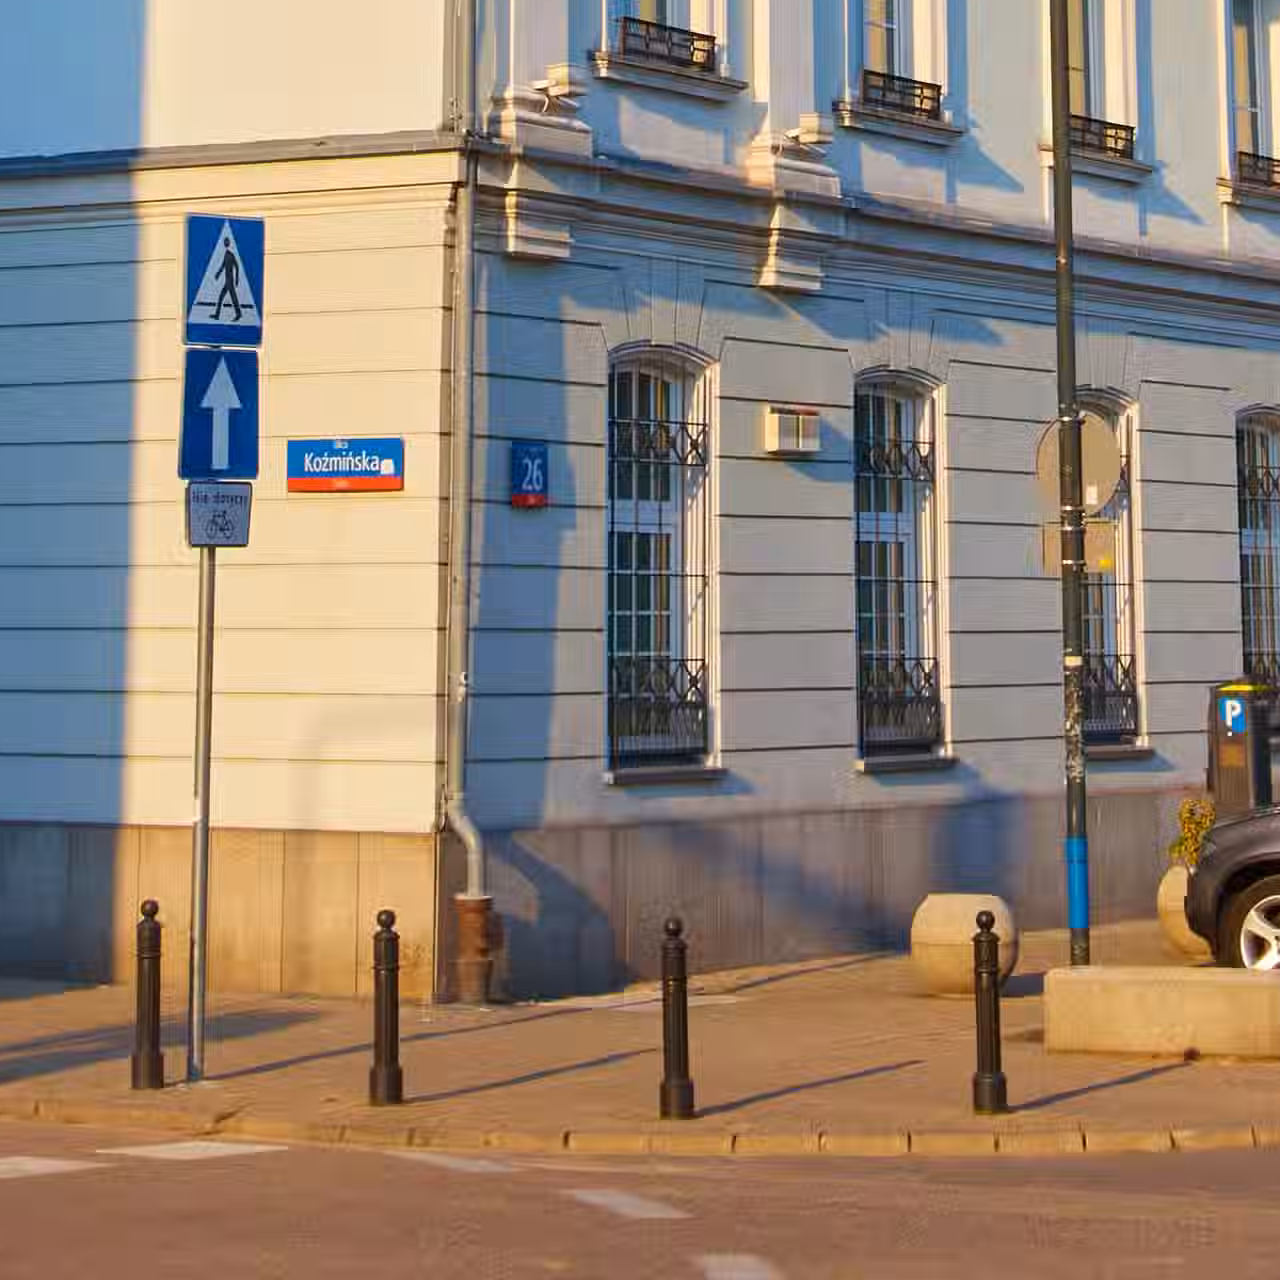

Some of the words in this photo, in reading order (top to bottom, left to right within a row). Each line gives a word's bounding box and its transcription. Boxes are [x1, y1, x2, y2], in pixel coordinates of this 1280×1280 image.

[303, 451, 380, 472] Koźmińska
[521, 457, 544, 491] 26
[1225, 699, 1242, 727] P
